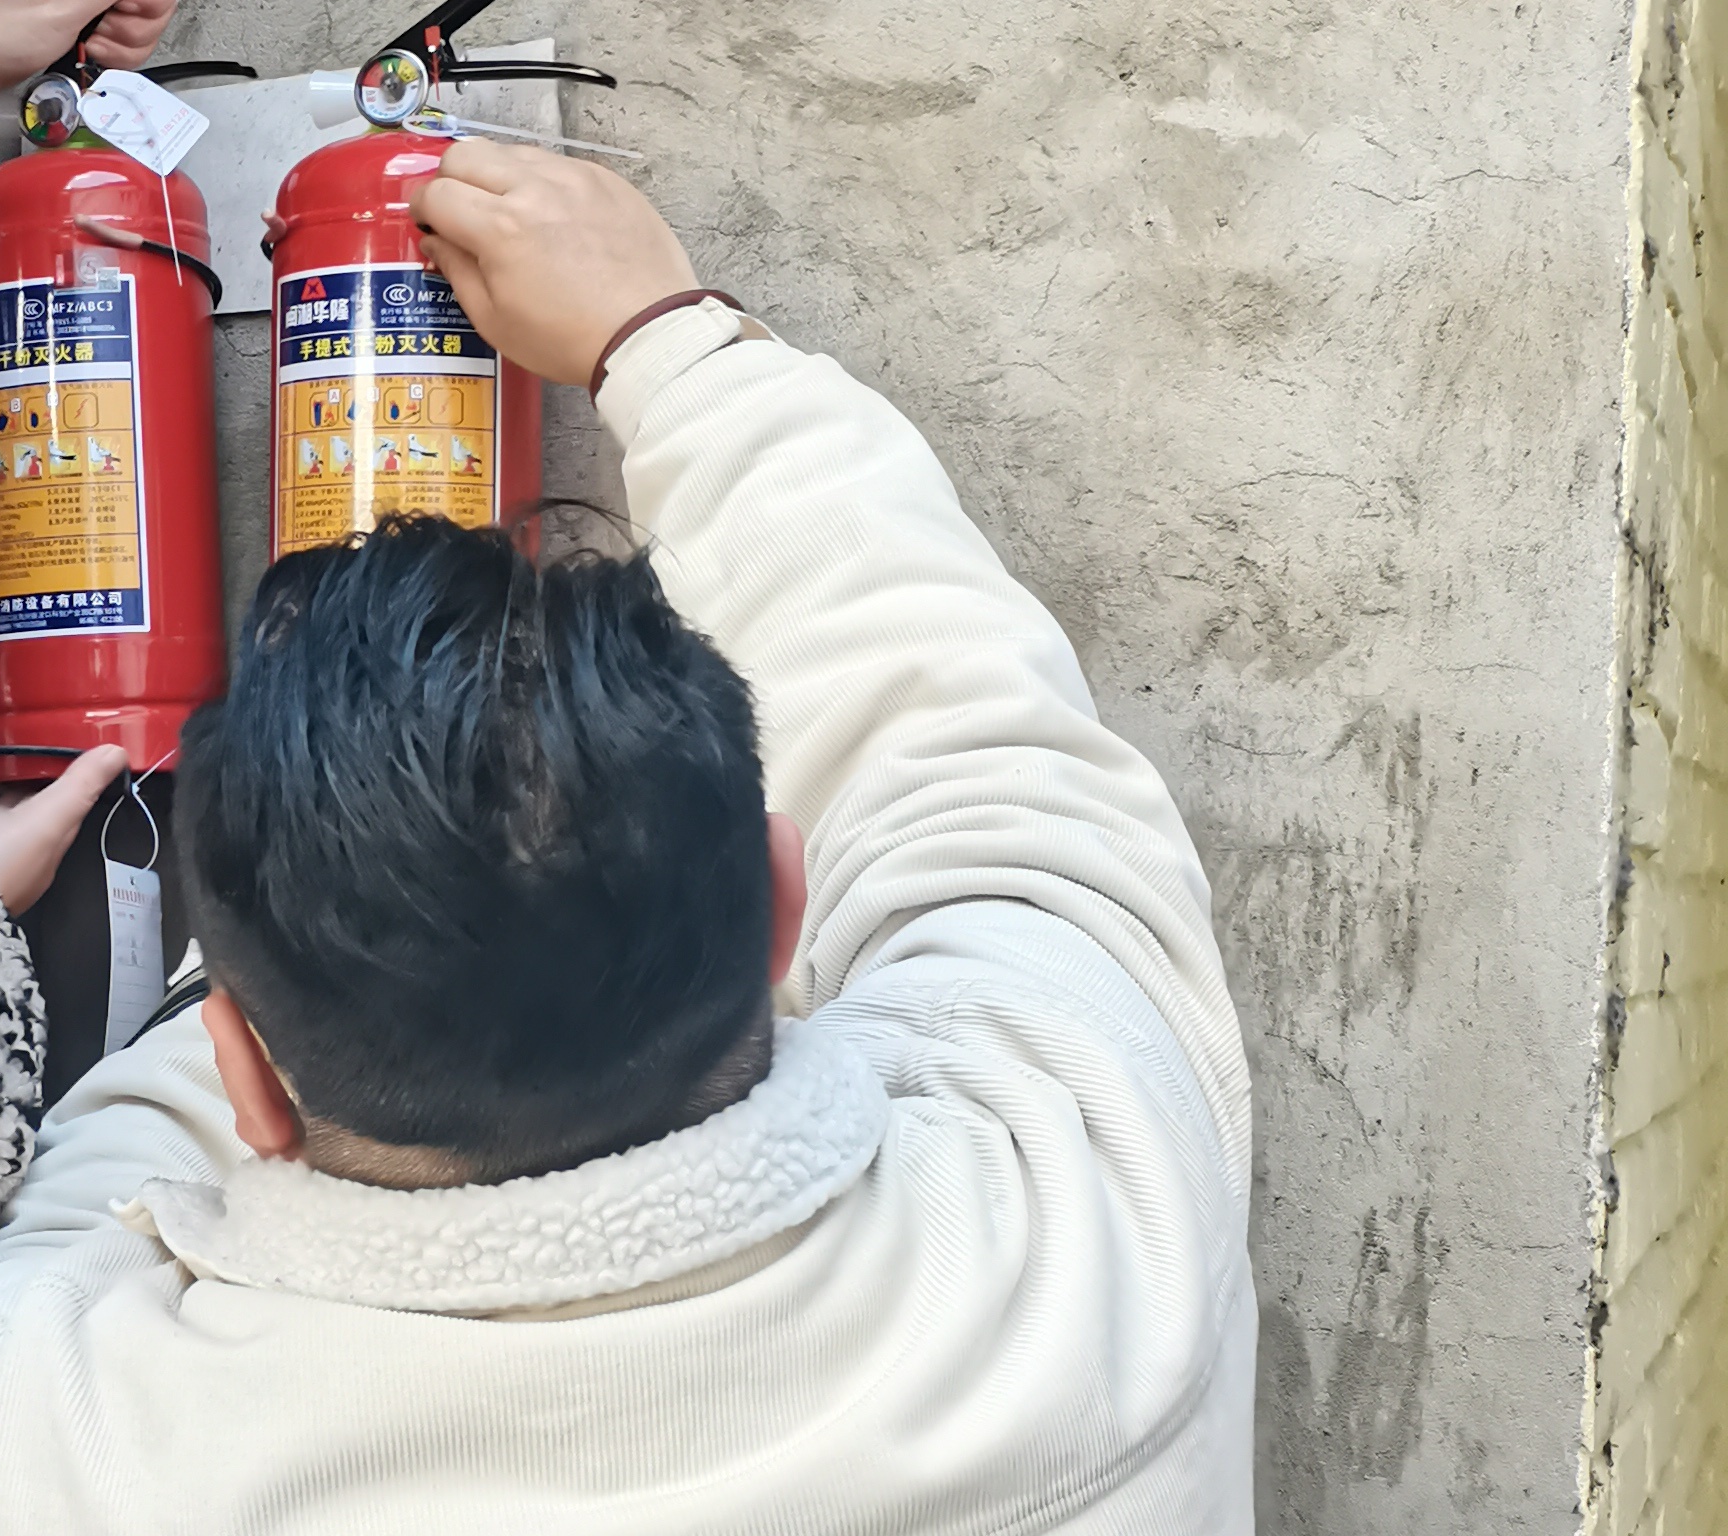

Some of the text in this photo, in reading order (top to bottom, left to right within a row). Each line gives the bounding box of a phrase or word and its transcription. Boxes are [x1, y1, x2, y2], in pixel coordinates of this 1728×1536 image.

[299, 334, 462, 360] 手提式干粉灭火器
